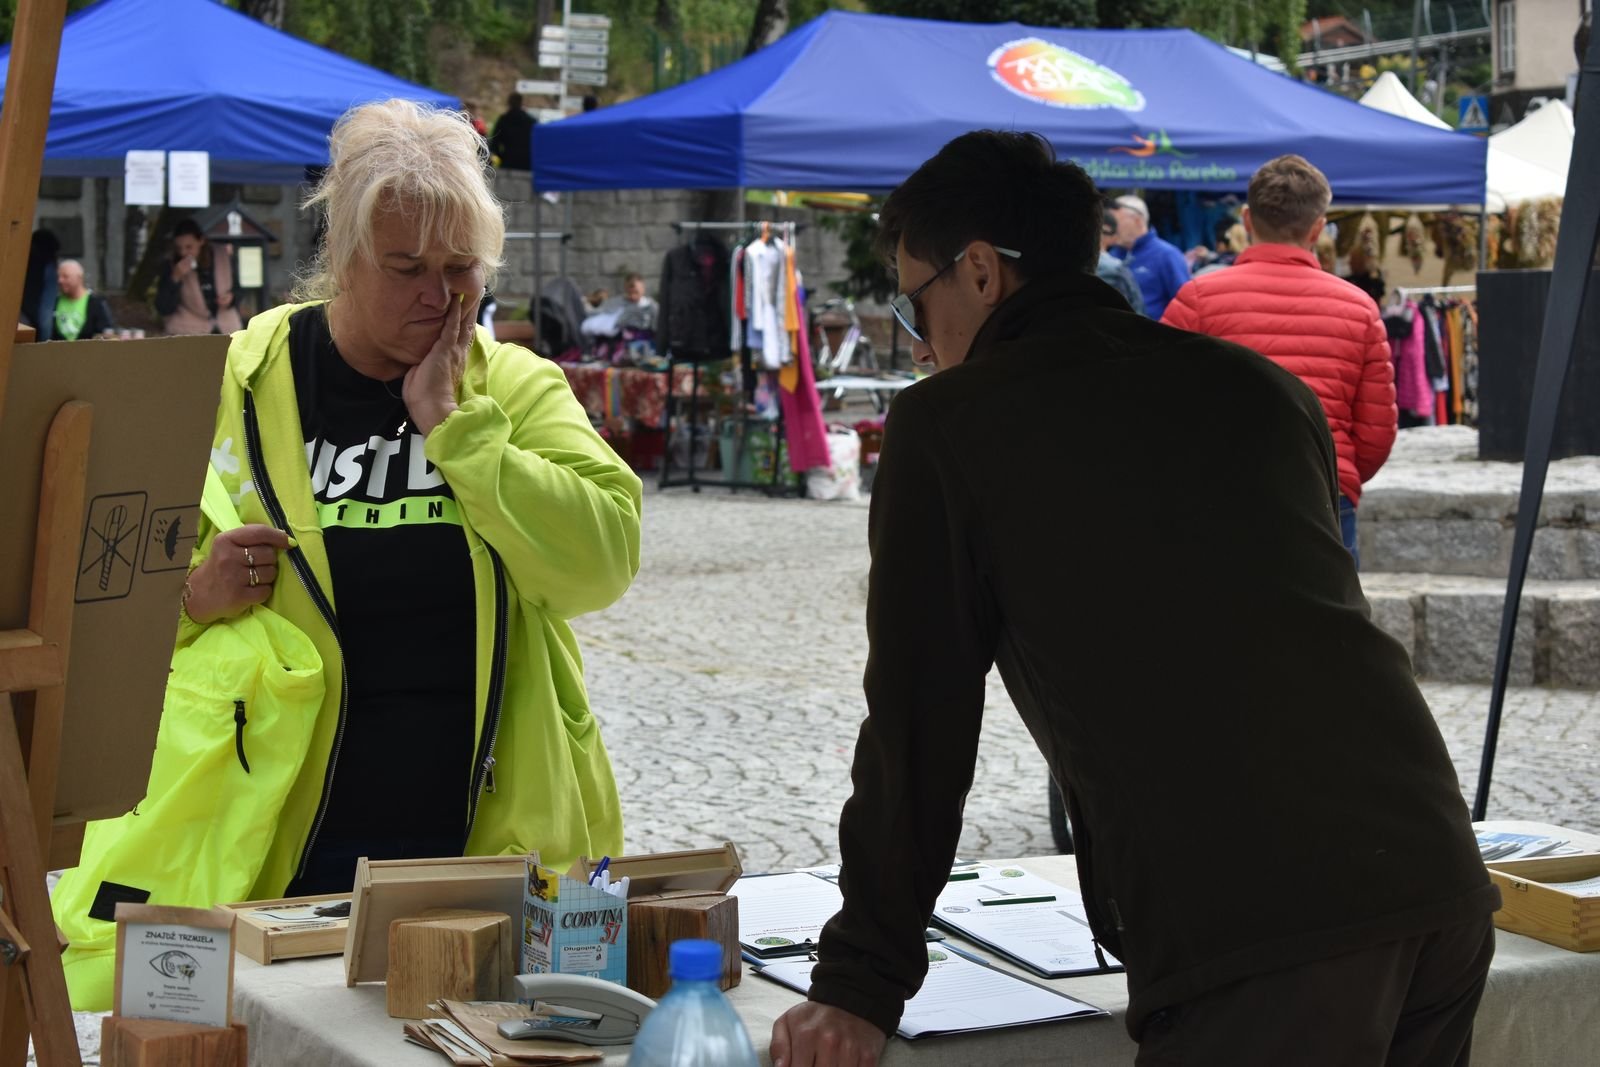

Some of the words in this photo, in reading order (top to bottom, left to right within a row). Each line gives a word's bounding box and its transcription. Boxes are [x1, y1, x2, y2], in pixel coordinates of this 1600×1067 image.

[304, 435, 401, 499] UST
[407, 433, 446, 490] D
[337, 501, 443, 524] THIN
[524, 901, 554, 927] CORVINA
[561, 907, 624, 929] CORVINA
[179, 934, 214, 944] TRZMIELA
[600, 921, 622, 944] 51
